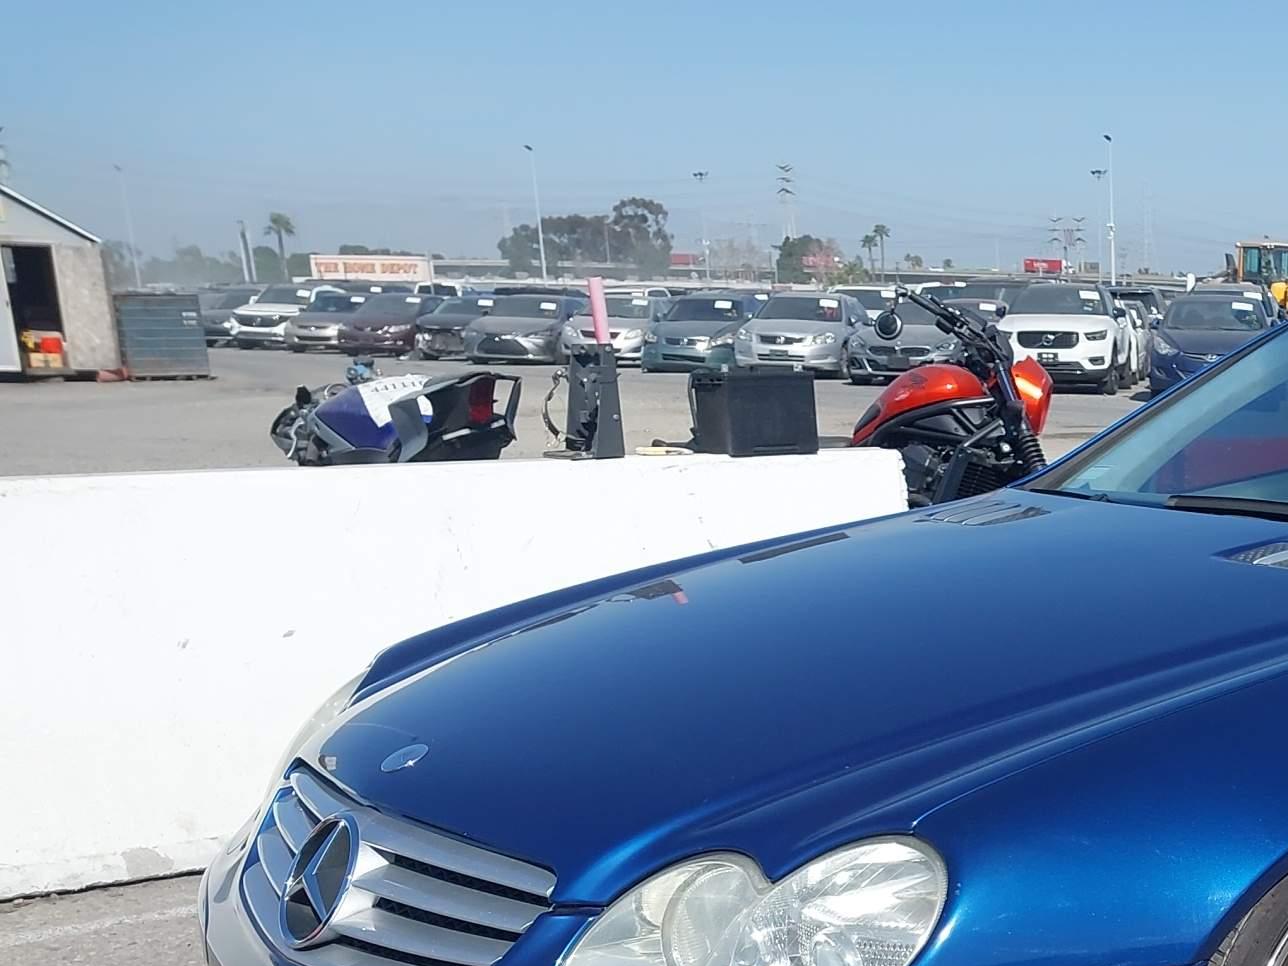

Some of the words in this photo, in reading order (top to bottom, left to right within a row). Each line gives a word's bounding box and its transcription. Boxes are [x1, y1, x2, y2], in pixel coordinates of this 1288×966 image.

[315, 262, 339, 273] THE
[343, 262, 376, 273] HOME
[381, 262, 418, 274] DEPOT
